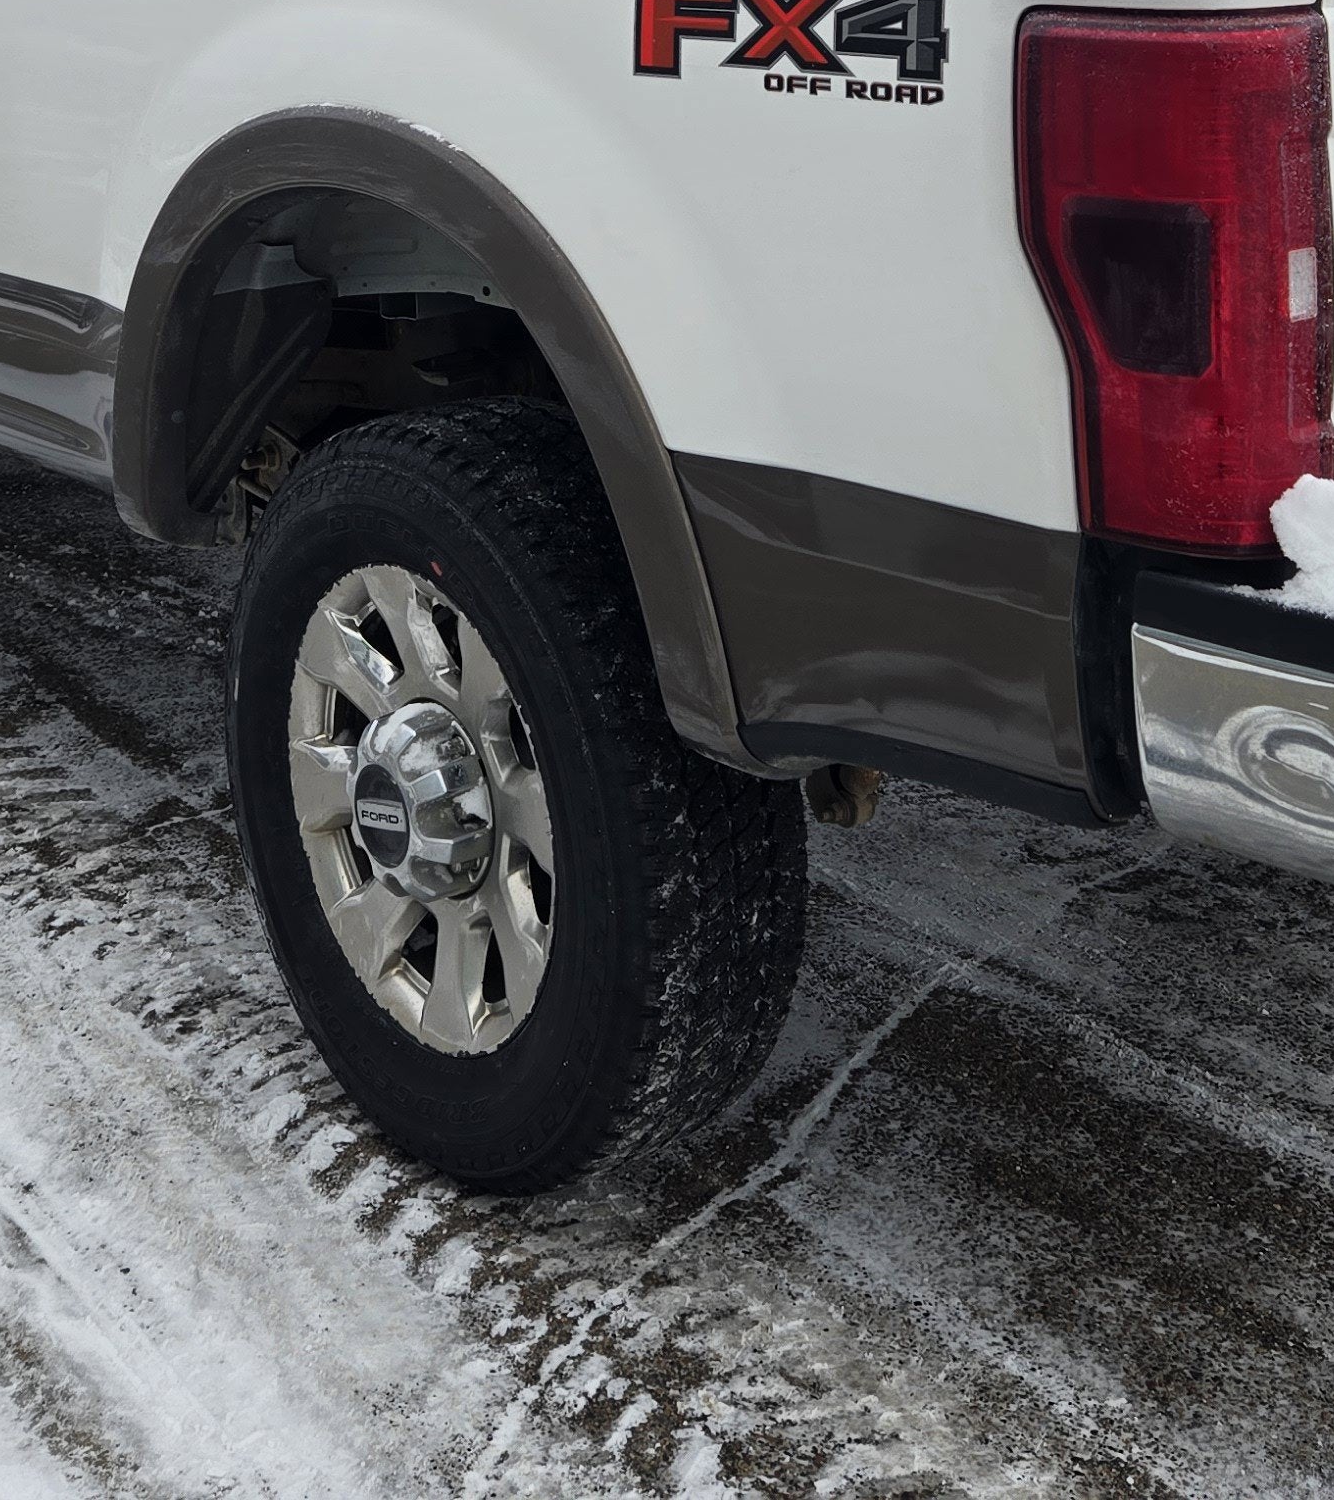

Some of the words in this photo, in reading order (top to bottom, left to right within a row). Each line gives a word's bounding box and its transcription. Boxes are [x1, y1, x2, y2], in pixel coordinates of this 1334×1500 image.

[764, 73, 832, 96] OFF
[845, 79, 945, 106] ROAD
[361, 810, 399, 825] FORD
